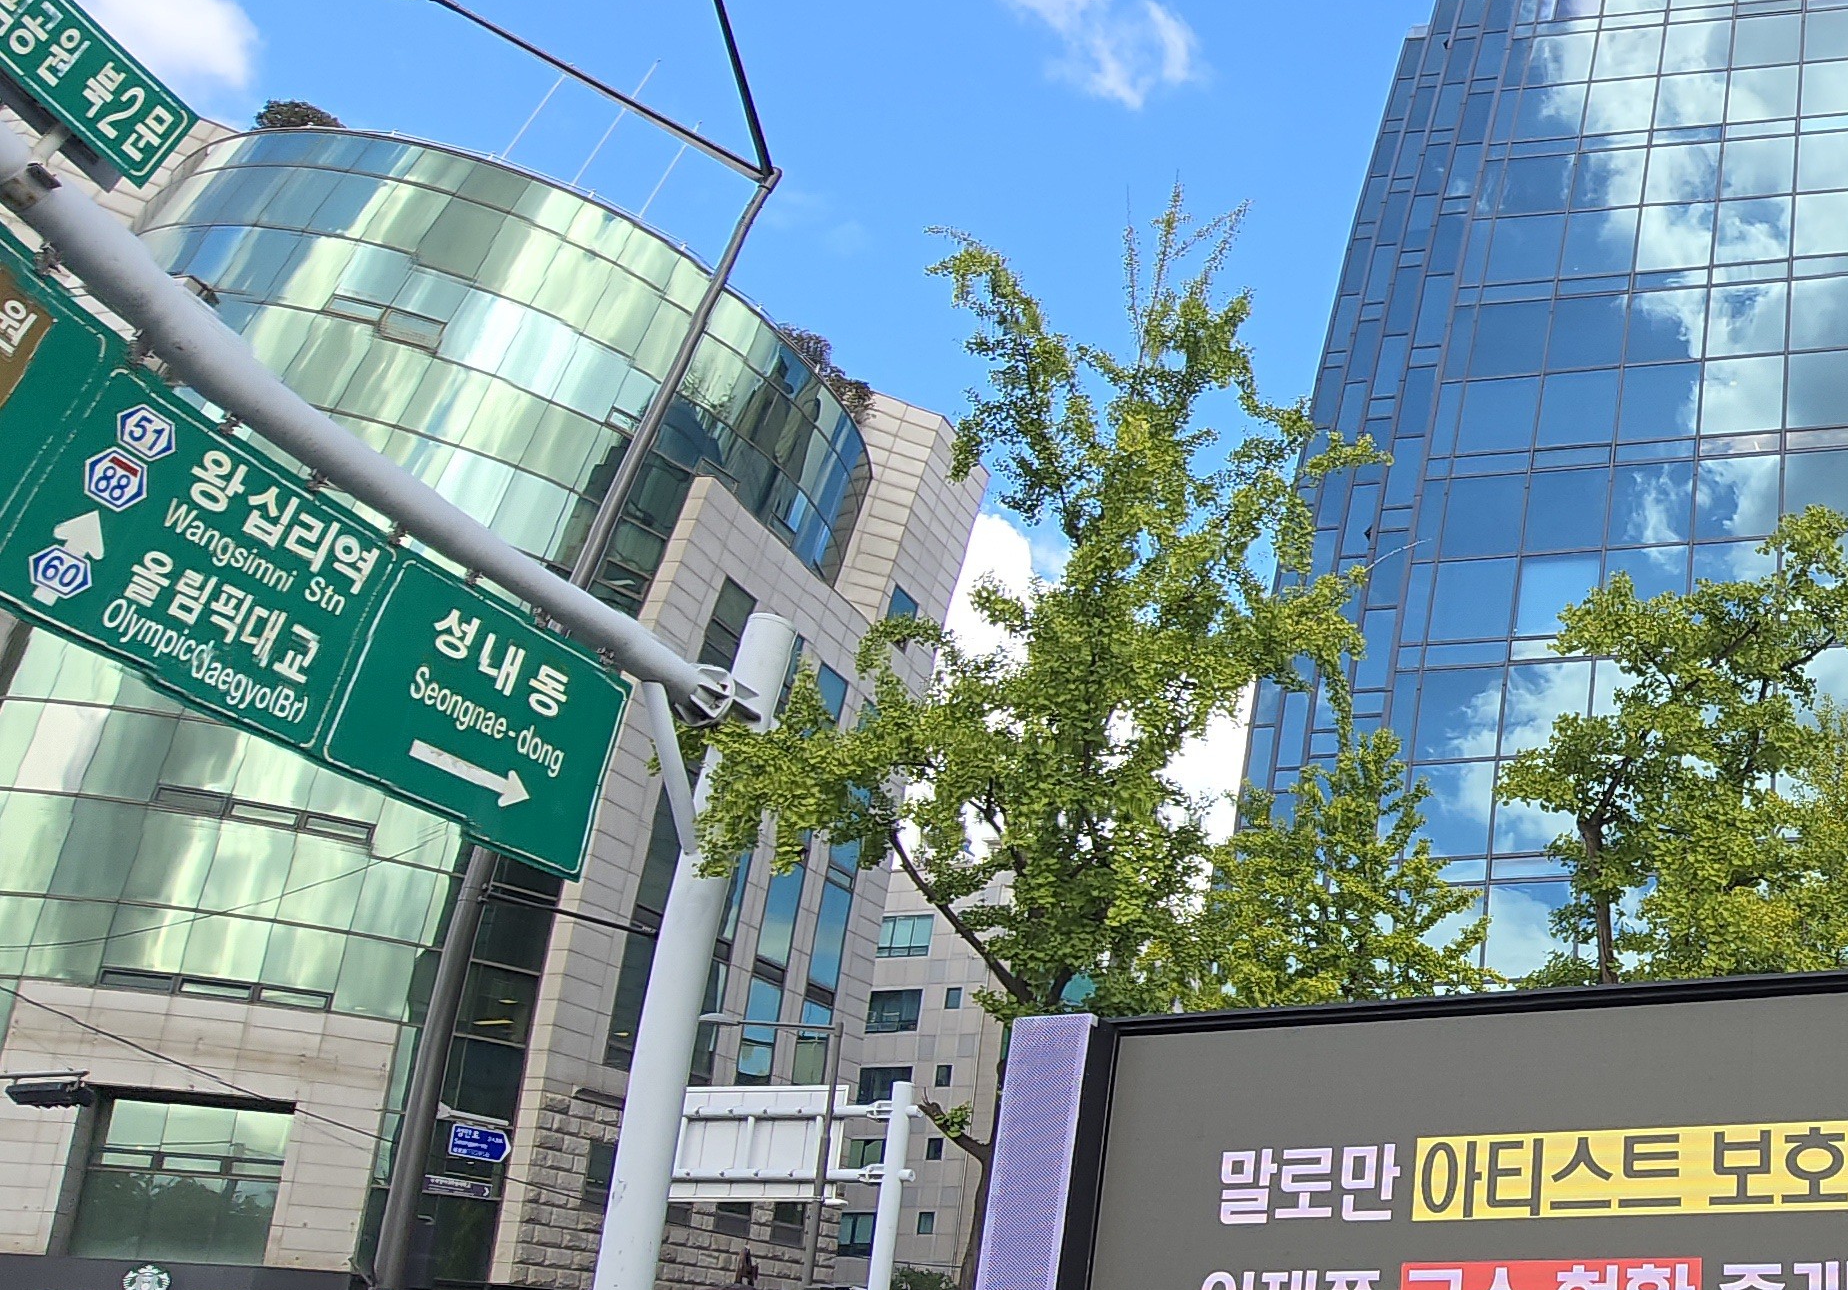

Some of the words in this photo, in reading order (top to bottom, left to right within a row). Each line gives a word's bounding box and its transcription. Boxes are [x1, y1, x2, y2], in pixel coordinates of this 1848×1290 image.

[82, 61, 175, 162] 북2문
[97, 464, 132, 504] 88
[128, 416, 165, 452] 51
[40, 554, 82, 589] 60
[164, 497, 298, 593] Wangsimni
[304, 575, 347, 616] Stn
[190, 450, 380, 595] 왕십리역
[123, 551, 321, 684] 올림픽대교
[433, 608, 569, 717] 성내동
[409, 665, 566, 778] Seongnae-dong
[1219, 1143, 1400, 1226] 말로만
[1417, 1133, 1683, 1221] 아티스트
[1707, 1127, 1848, 1209] 보호
